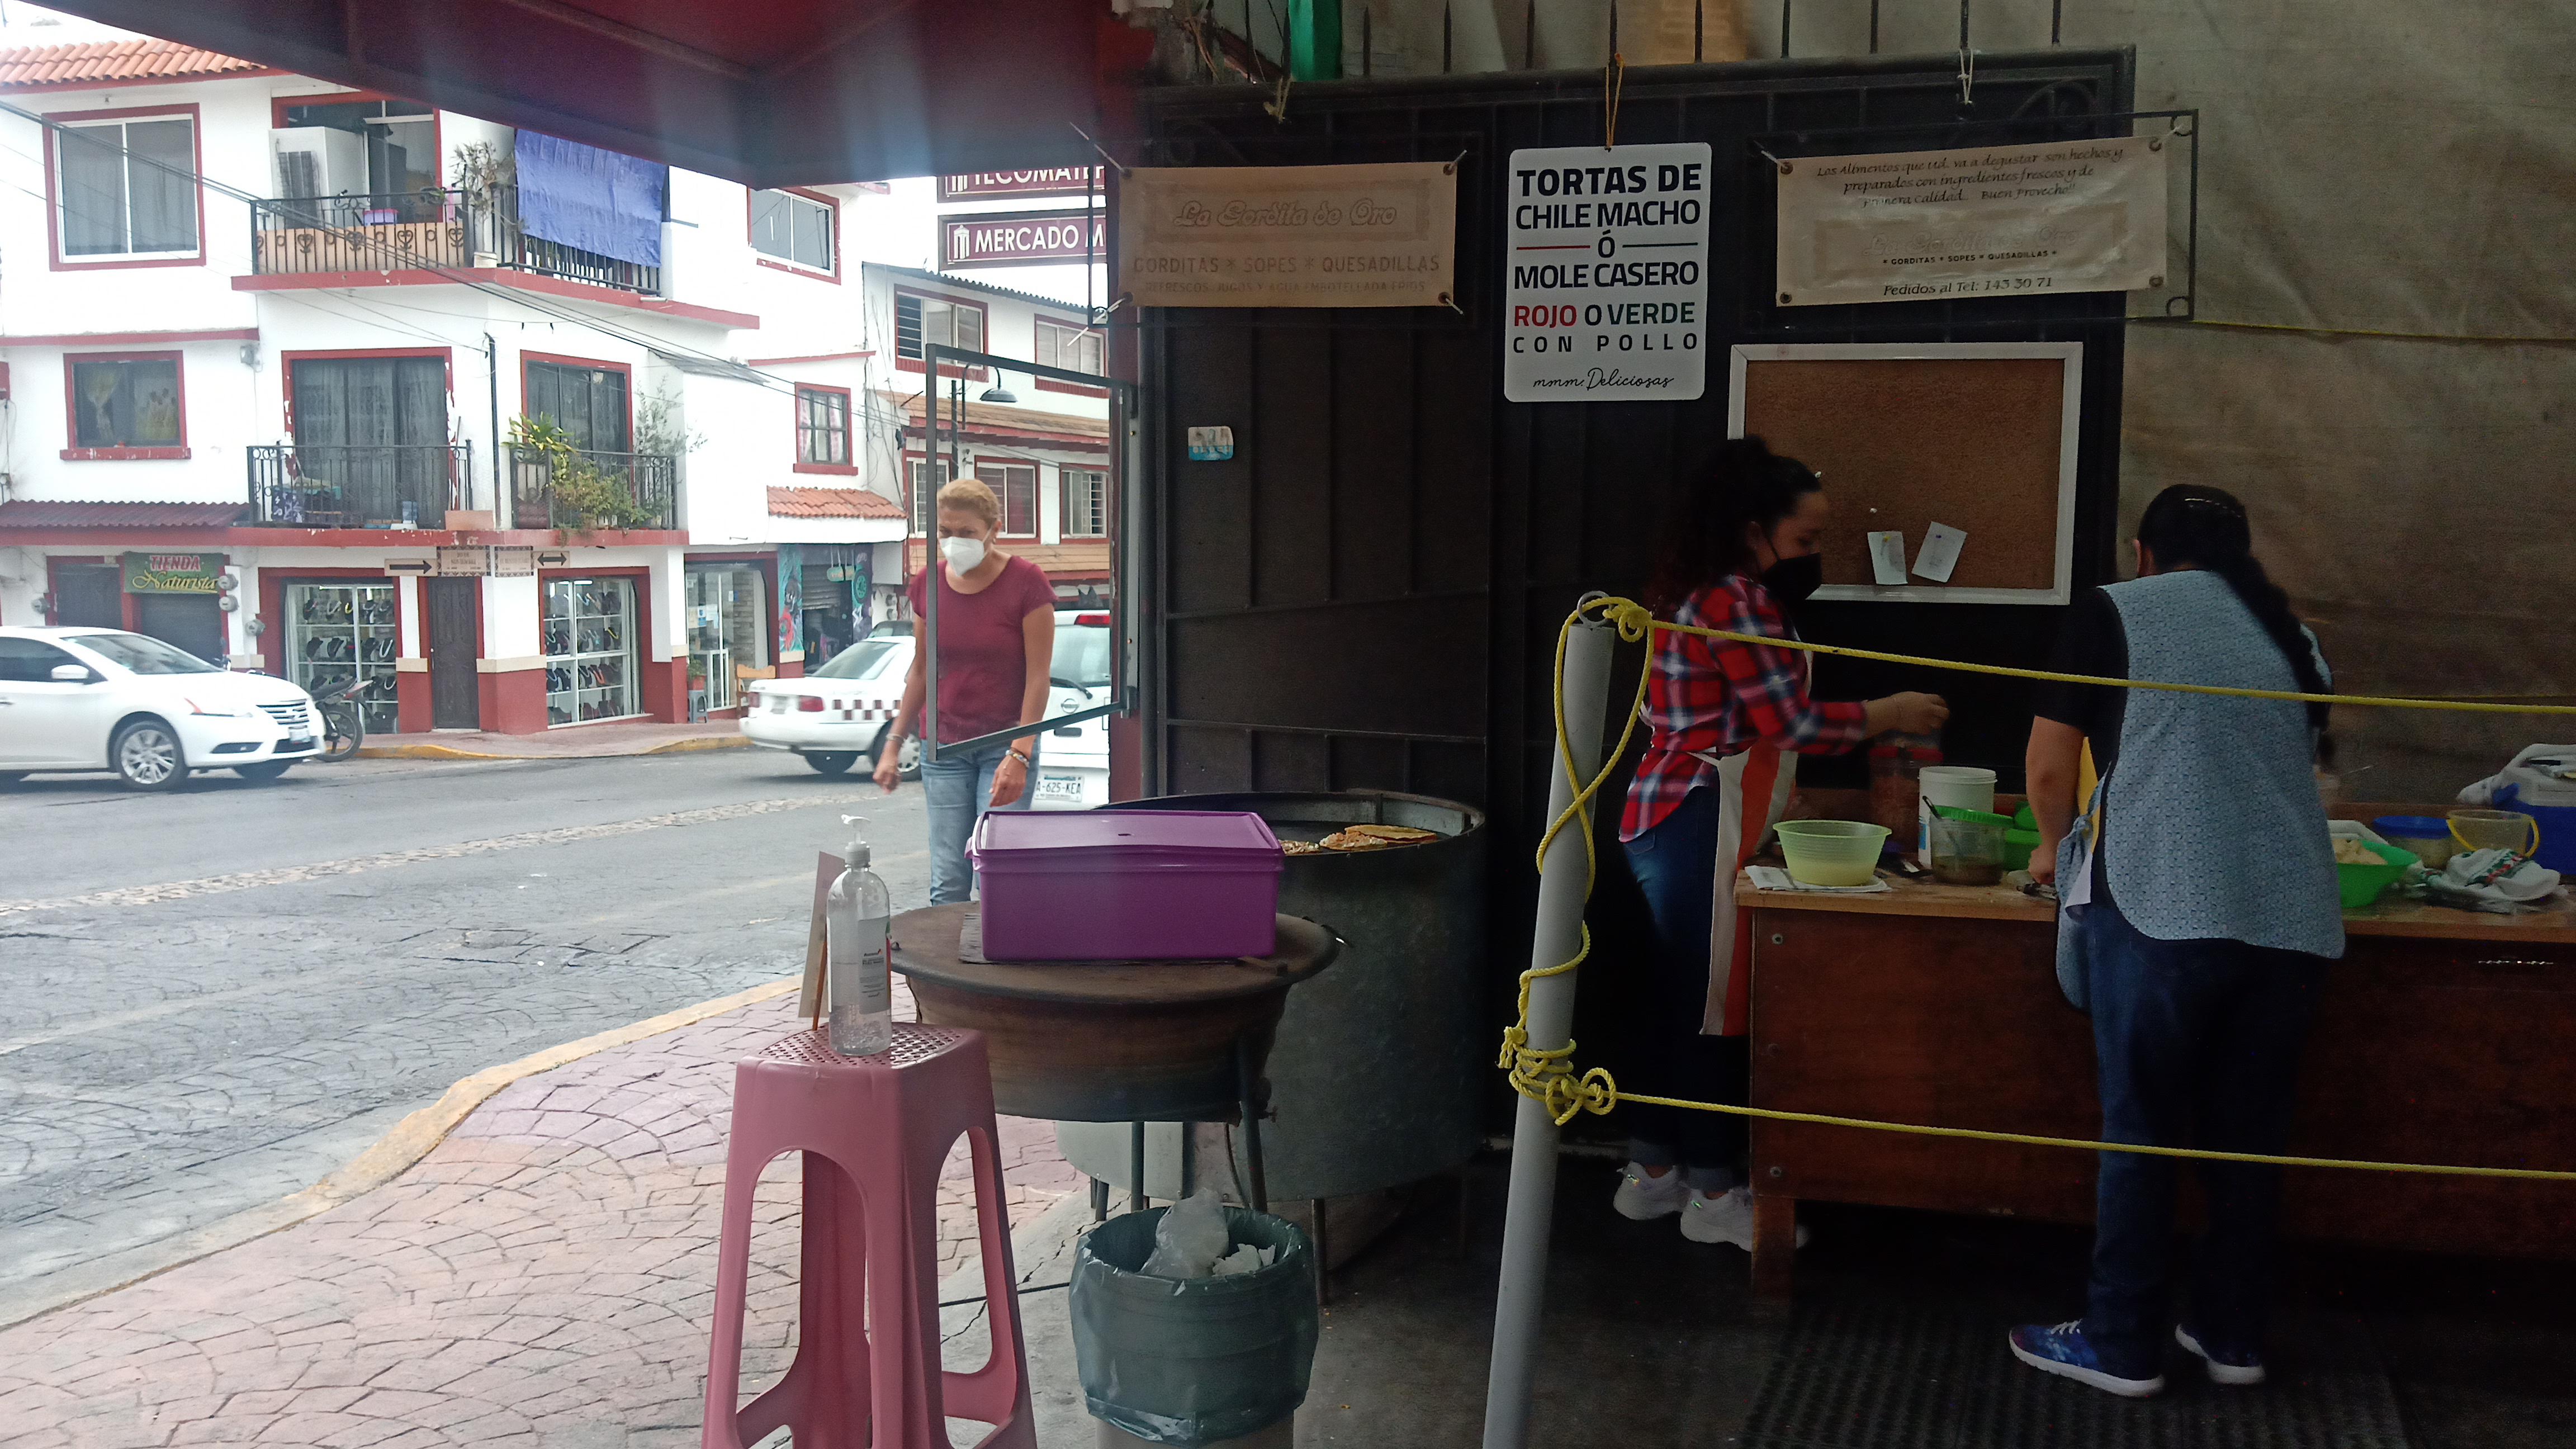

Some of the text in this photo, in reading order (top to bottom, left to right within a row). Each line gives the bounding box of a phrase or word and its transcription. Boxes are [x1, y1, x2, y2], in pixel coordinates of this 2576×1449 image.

[1902, 162, 1924, 175] que
[1982, 154, 2038, 170] degustar
[2045, 154, 2066, 162] son
[2070, 147, 2111, 160] hechos
[2113, 149, 2124, 163] y
[1517, 163, 1702, 196] TORTAS DE
[1844, 165, 2094, 195] preparados con ingredientes frescos y de
[1174, 198, 1396, 226] La Gordita de Oro
[1516, 200, 1701, 229] CHILE MACHO
[976, 225, 1079, 253] MERCADO
[1598, 229, 1615, 258] Ó
[1243, 257, 1297, 273] SOPES
[1322, 255, 1439, 273] QUESADILLAS
[1891, 257, 1935, 265] GORDITAS
[1988, 250, 2048, 261] QUESADILLAS
[1514, 261, 1699, 289] MOLE CASERO
[1883, 283, 1936, 296] Pedidos
[1940, 282, 1952, 294] al
[1957, 281, 1978, 292] Tel:
[2037, 277, 2052, 287] 71
[1514, 302, 1695, 328] ROJO O VERDE
[1513, 333, 1697, 353] CON POLLO
[1587, 367, 1674, 391] Deliciosas
[150, 555, 201, 571] TIENDA
[132, 569, 219, 592] Naturista
